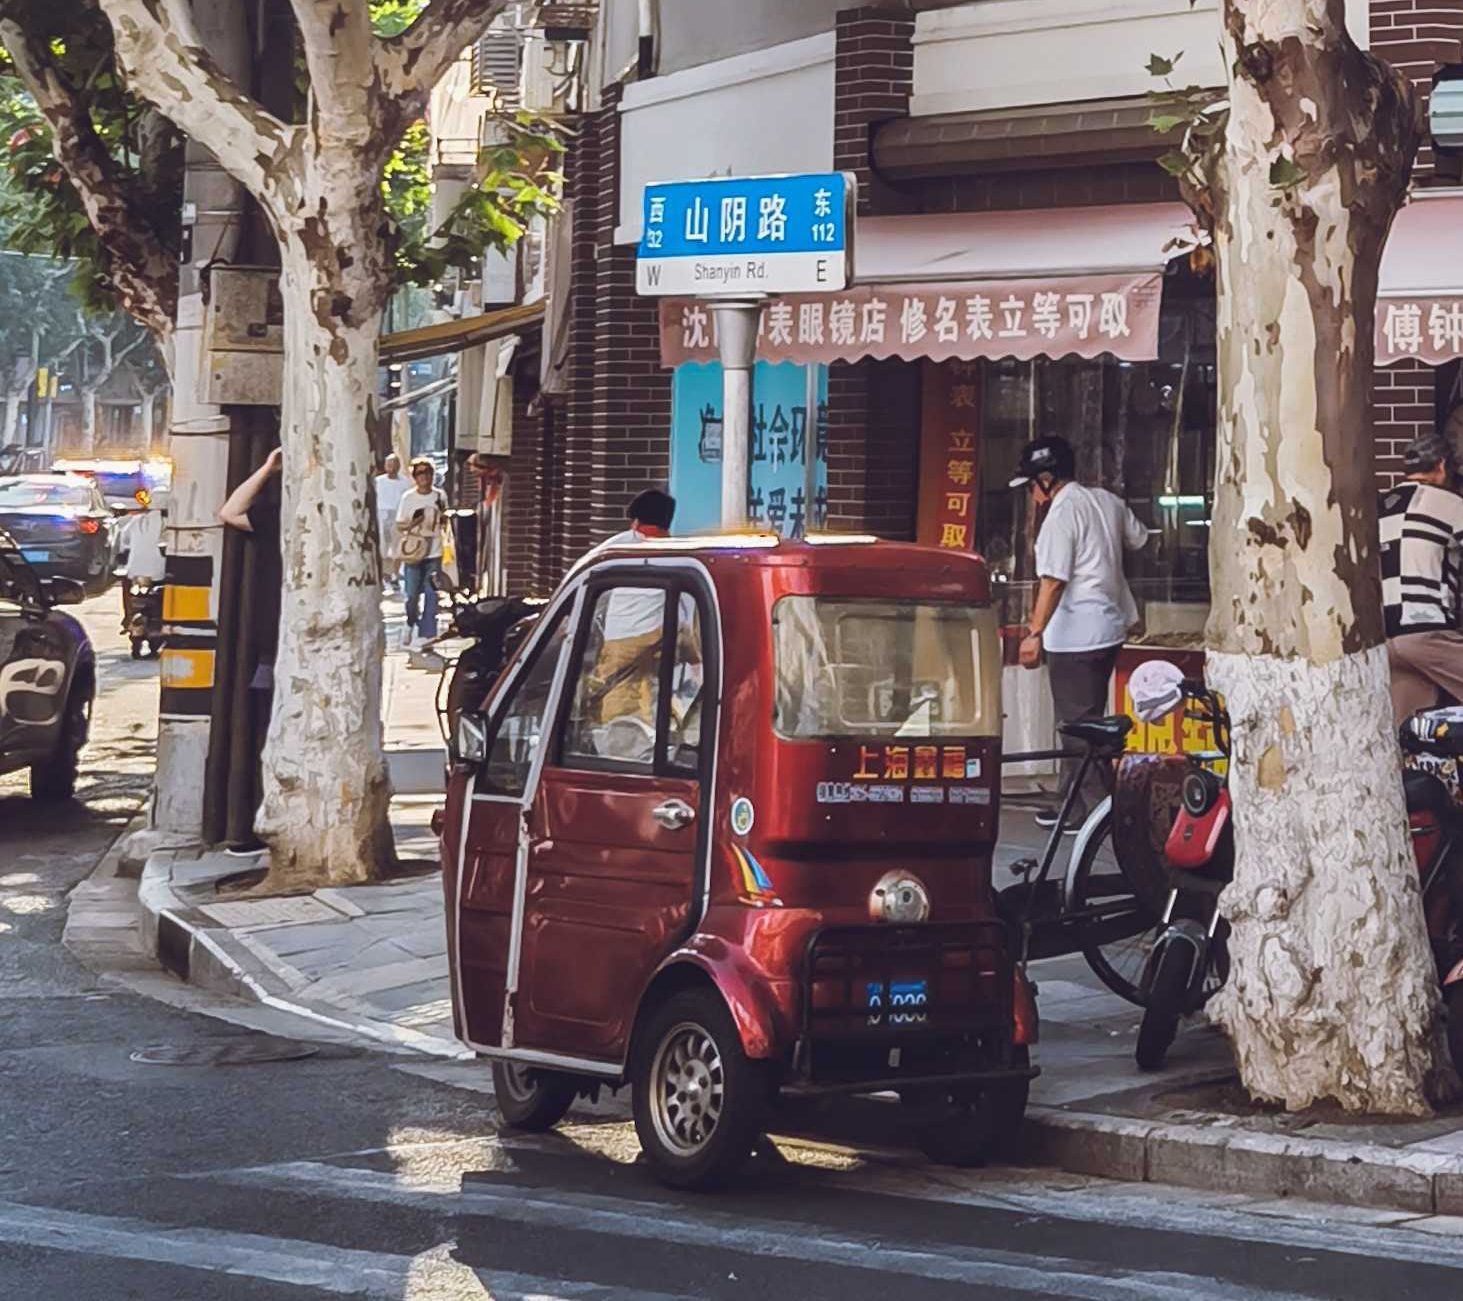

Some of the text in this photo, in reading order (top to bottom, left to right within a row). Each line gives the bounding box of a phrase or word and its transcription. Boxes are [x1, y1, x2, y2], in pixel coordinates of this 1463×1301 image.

[650, 197, 666, 224] 西
[813, 188, 832, 218] 东
[685, 194, 788, 243] 山阴路
[811, 223, 835, 242] 112
[647, 265, 661, 286] W
[694, 261, 769, 283] Shanyin Rd.
[816, 260, 827, 282] E
[683, 291, 1131, 348] 沈表眼镜店 修名表立等可取
